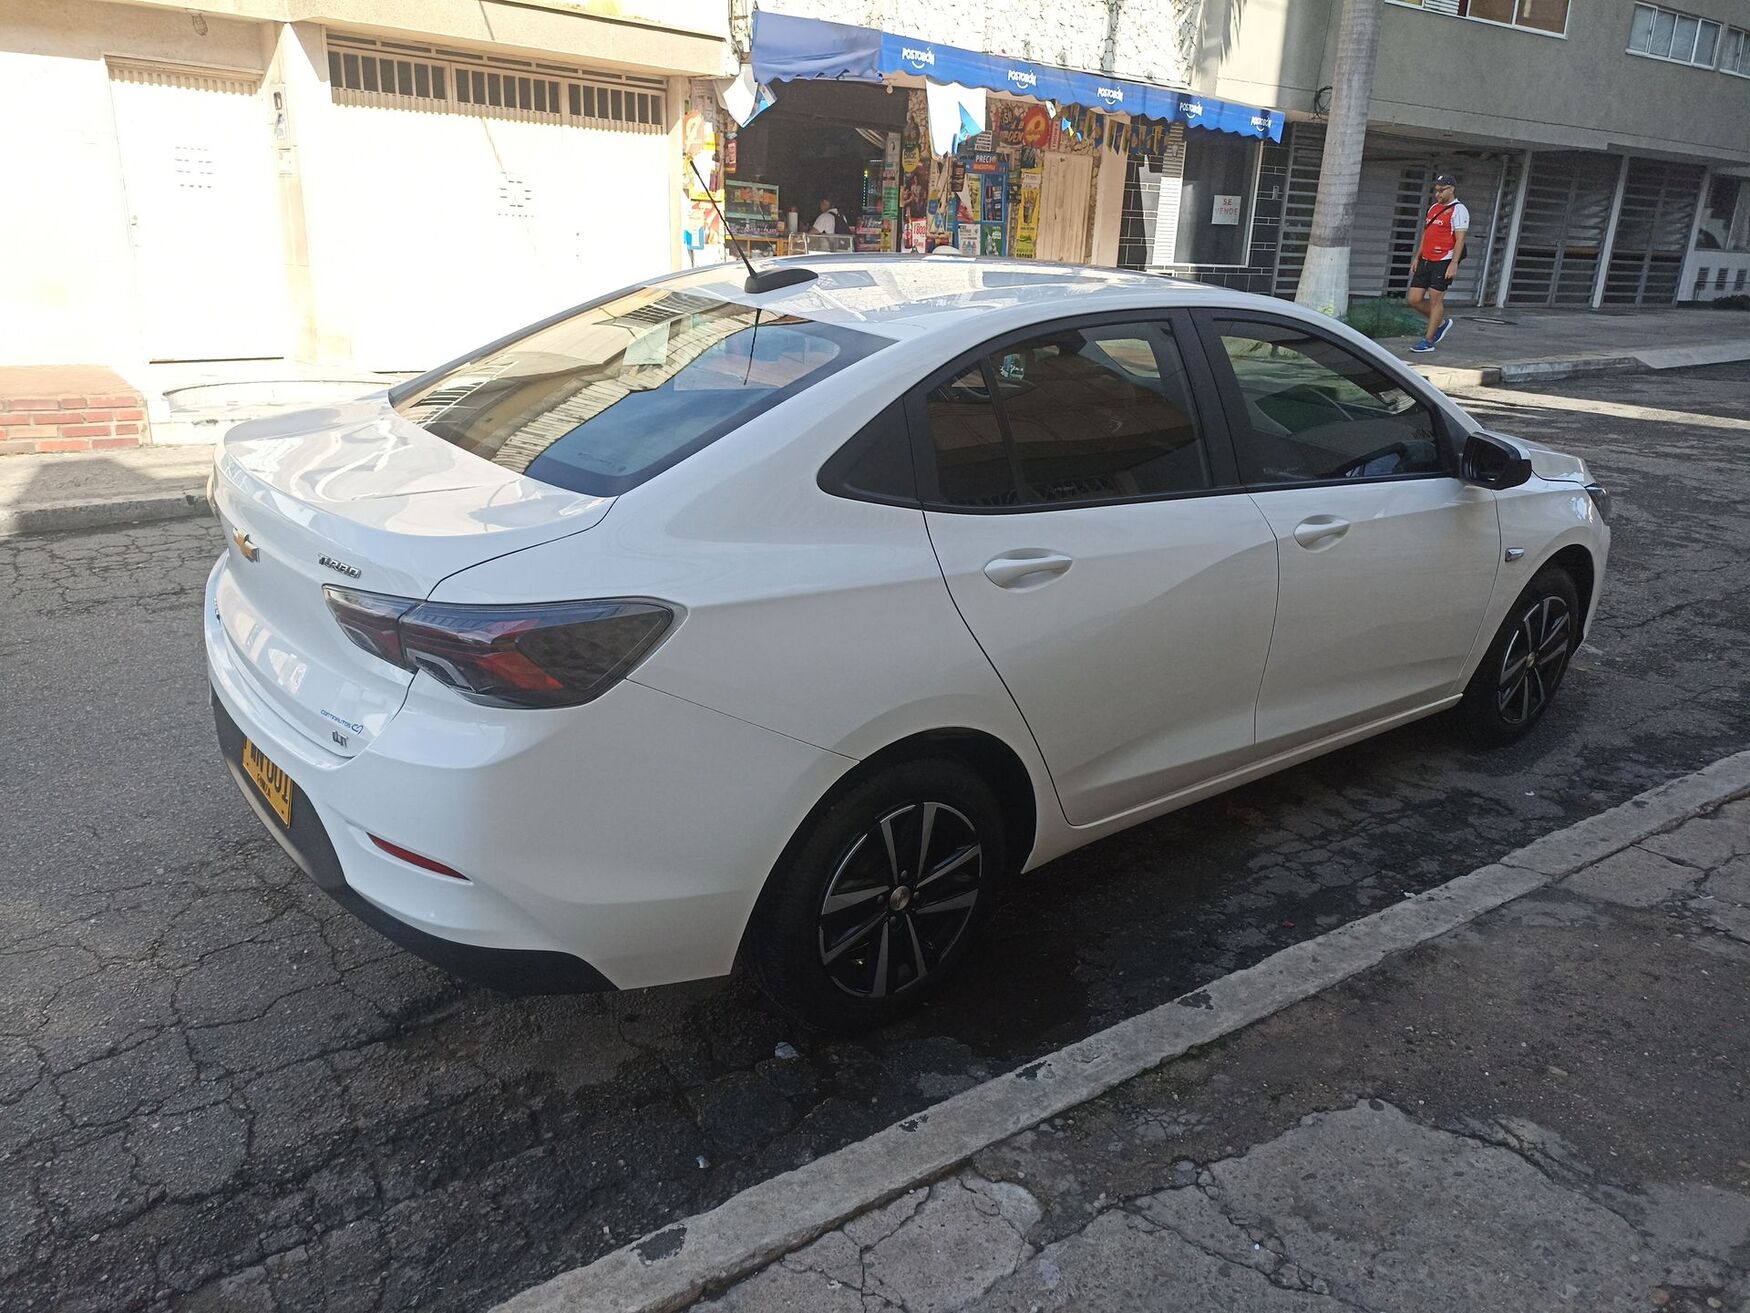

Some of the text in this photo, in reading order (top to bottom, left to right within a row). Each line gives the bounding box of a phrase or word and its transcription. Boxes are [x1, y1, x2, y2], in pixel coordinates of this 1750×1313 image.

[1223, 198, 1233, 206] SE
[1215, 207, 1239, 216] VENDE
[318, 552, 362, 579] TURBO
